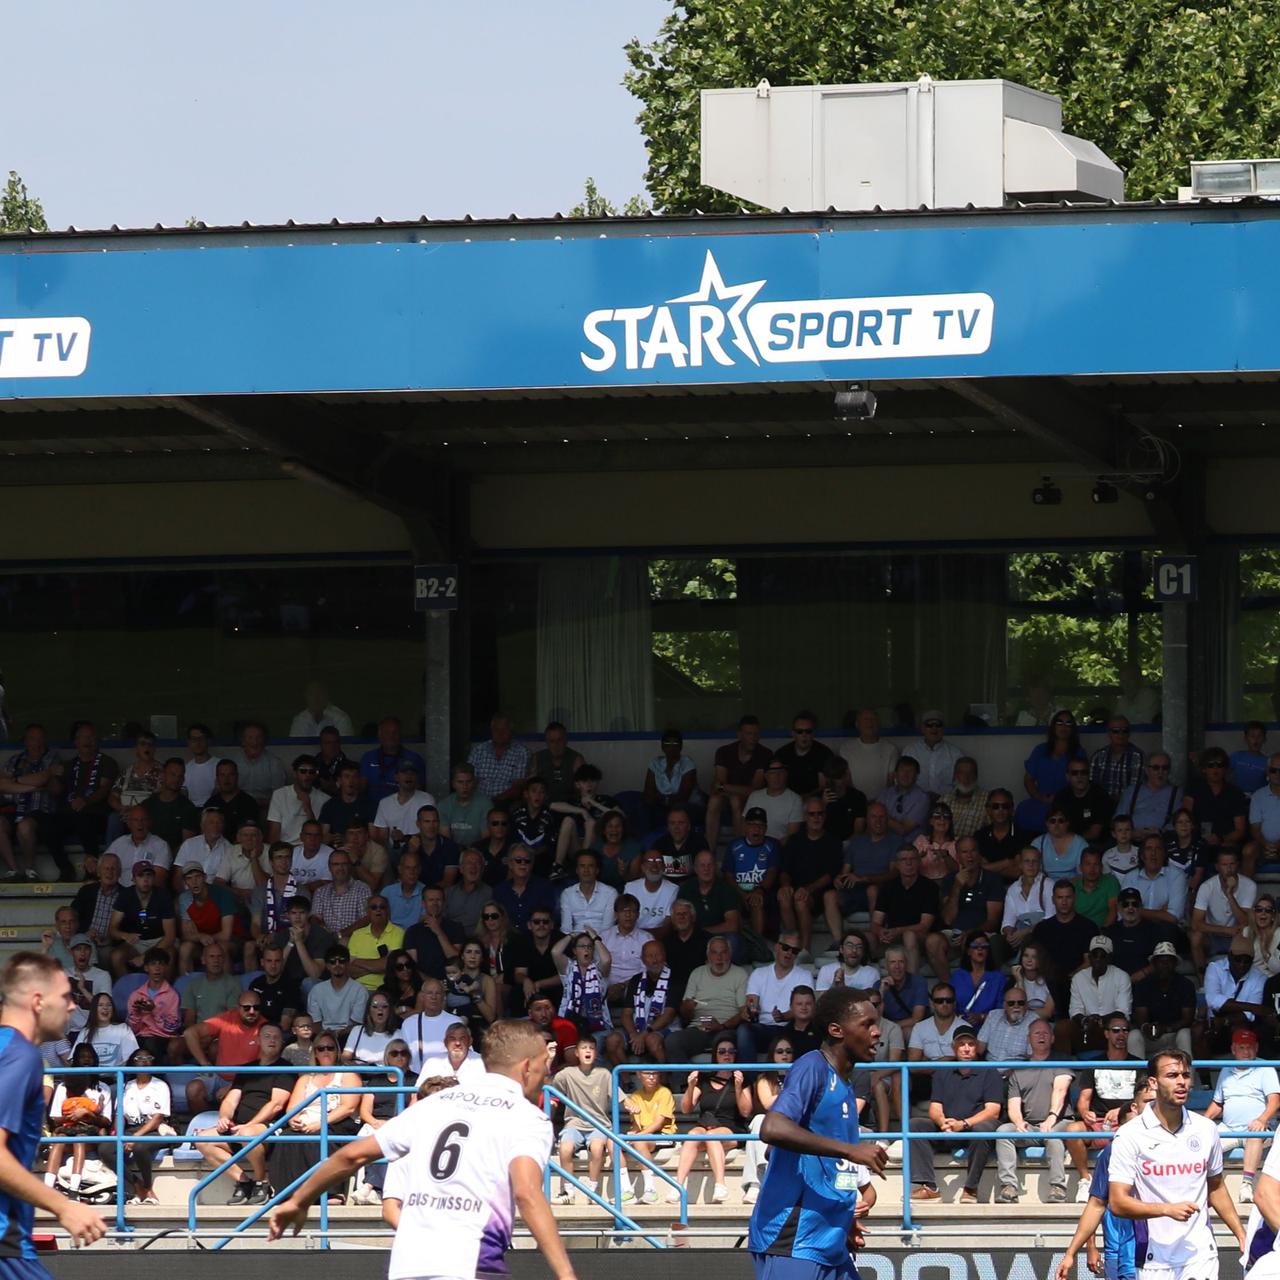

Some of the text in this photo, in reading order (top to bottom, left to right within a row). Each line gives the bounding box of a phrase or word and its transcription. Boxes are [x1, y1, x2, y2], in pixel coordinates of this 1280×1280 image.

[33, 332, 78, 362] TV
[580, 304, 981, 372] STAR SPORT TV
[415, 577, 457, 598] B2-2
[1159, 563, 1191, 595] C1
[642, 906, 664, 917] OSS
[429, 1120, 471, 1182] 6
